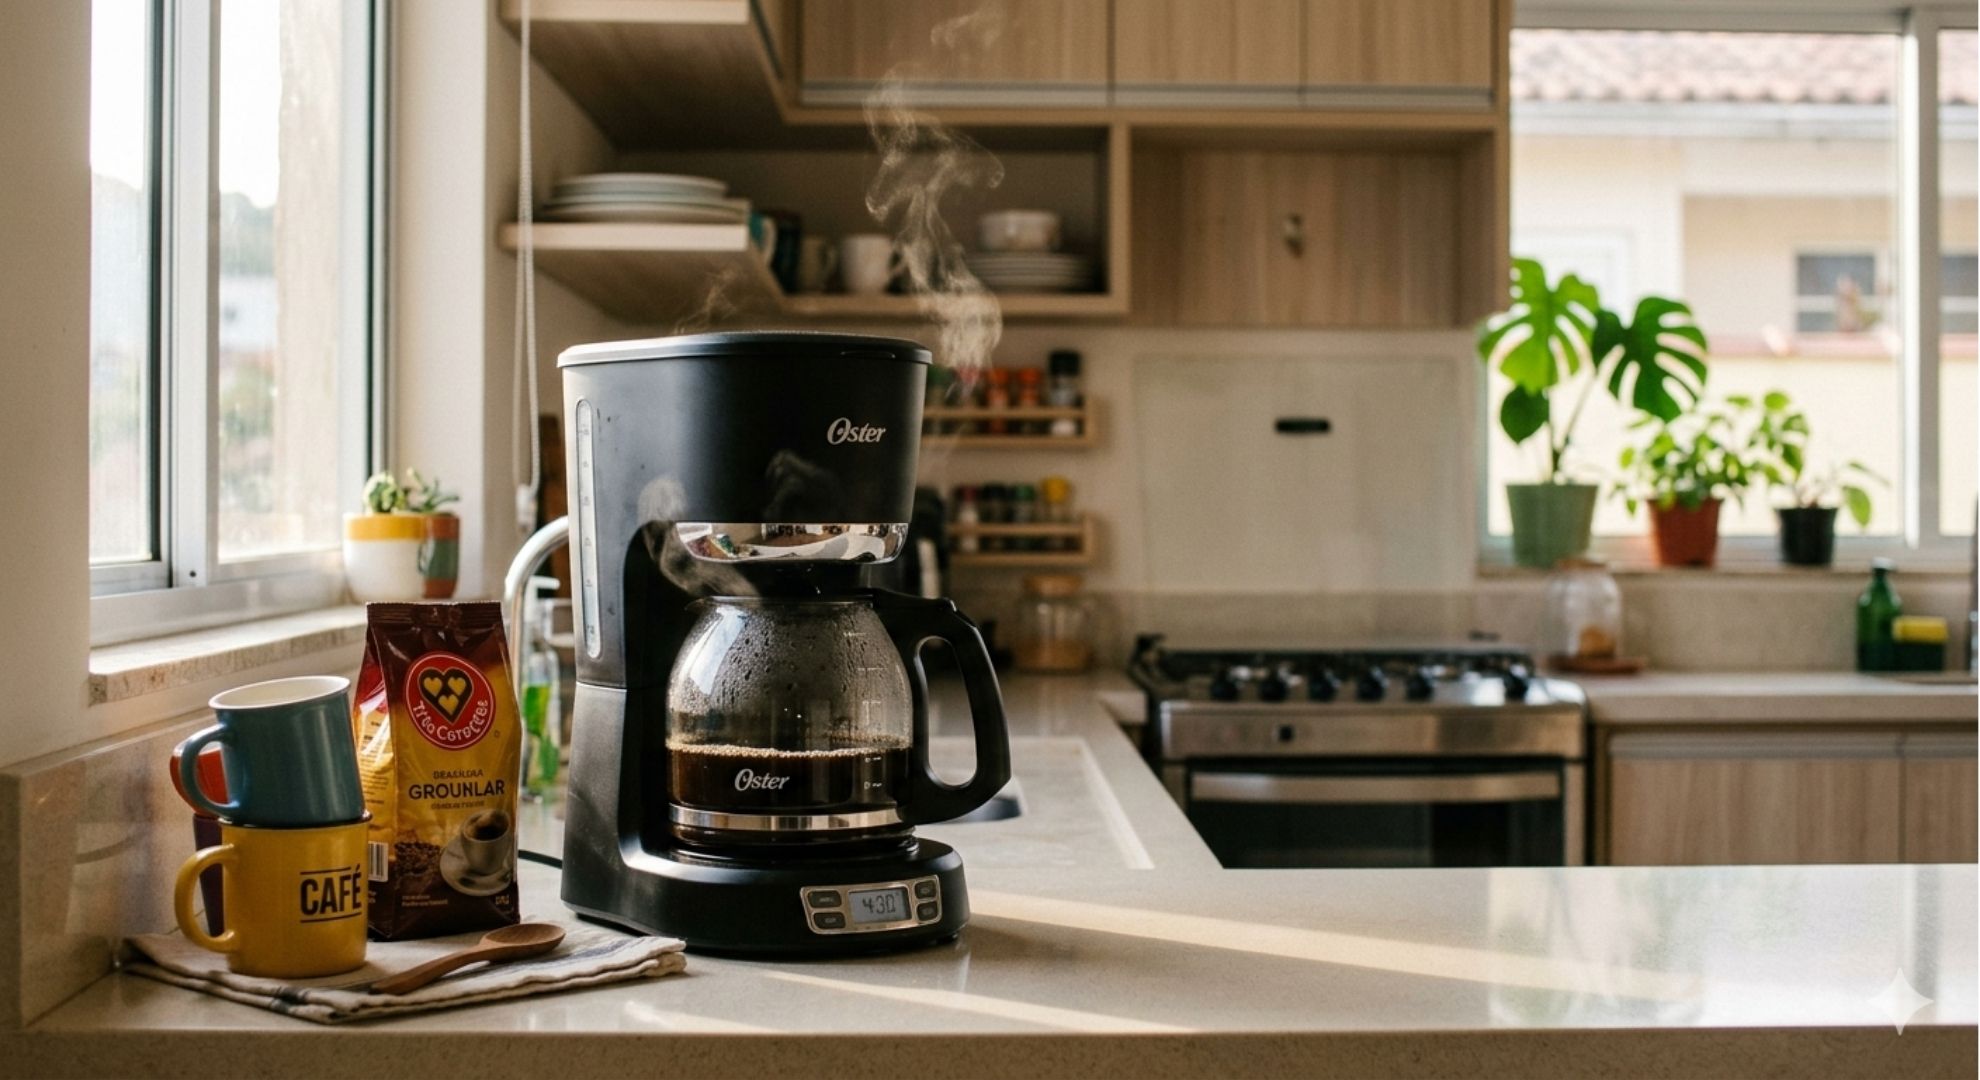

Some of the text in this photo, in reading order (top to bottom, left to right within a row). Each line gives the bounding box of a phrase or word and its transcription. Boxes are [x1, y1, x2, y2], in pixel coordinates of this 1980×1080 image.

[827, 417, 886, 445] Oster
[408, 780, 505, 800] GROUNLAR
[735, 768, 790, 791] Oster
[301, 863, 362, 916] CAFÉ
